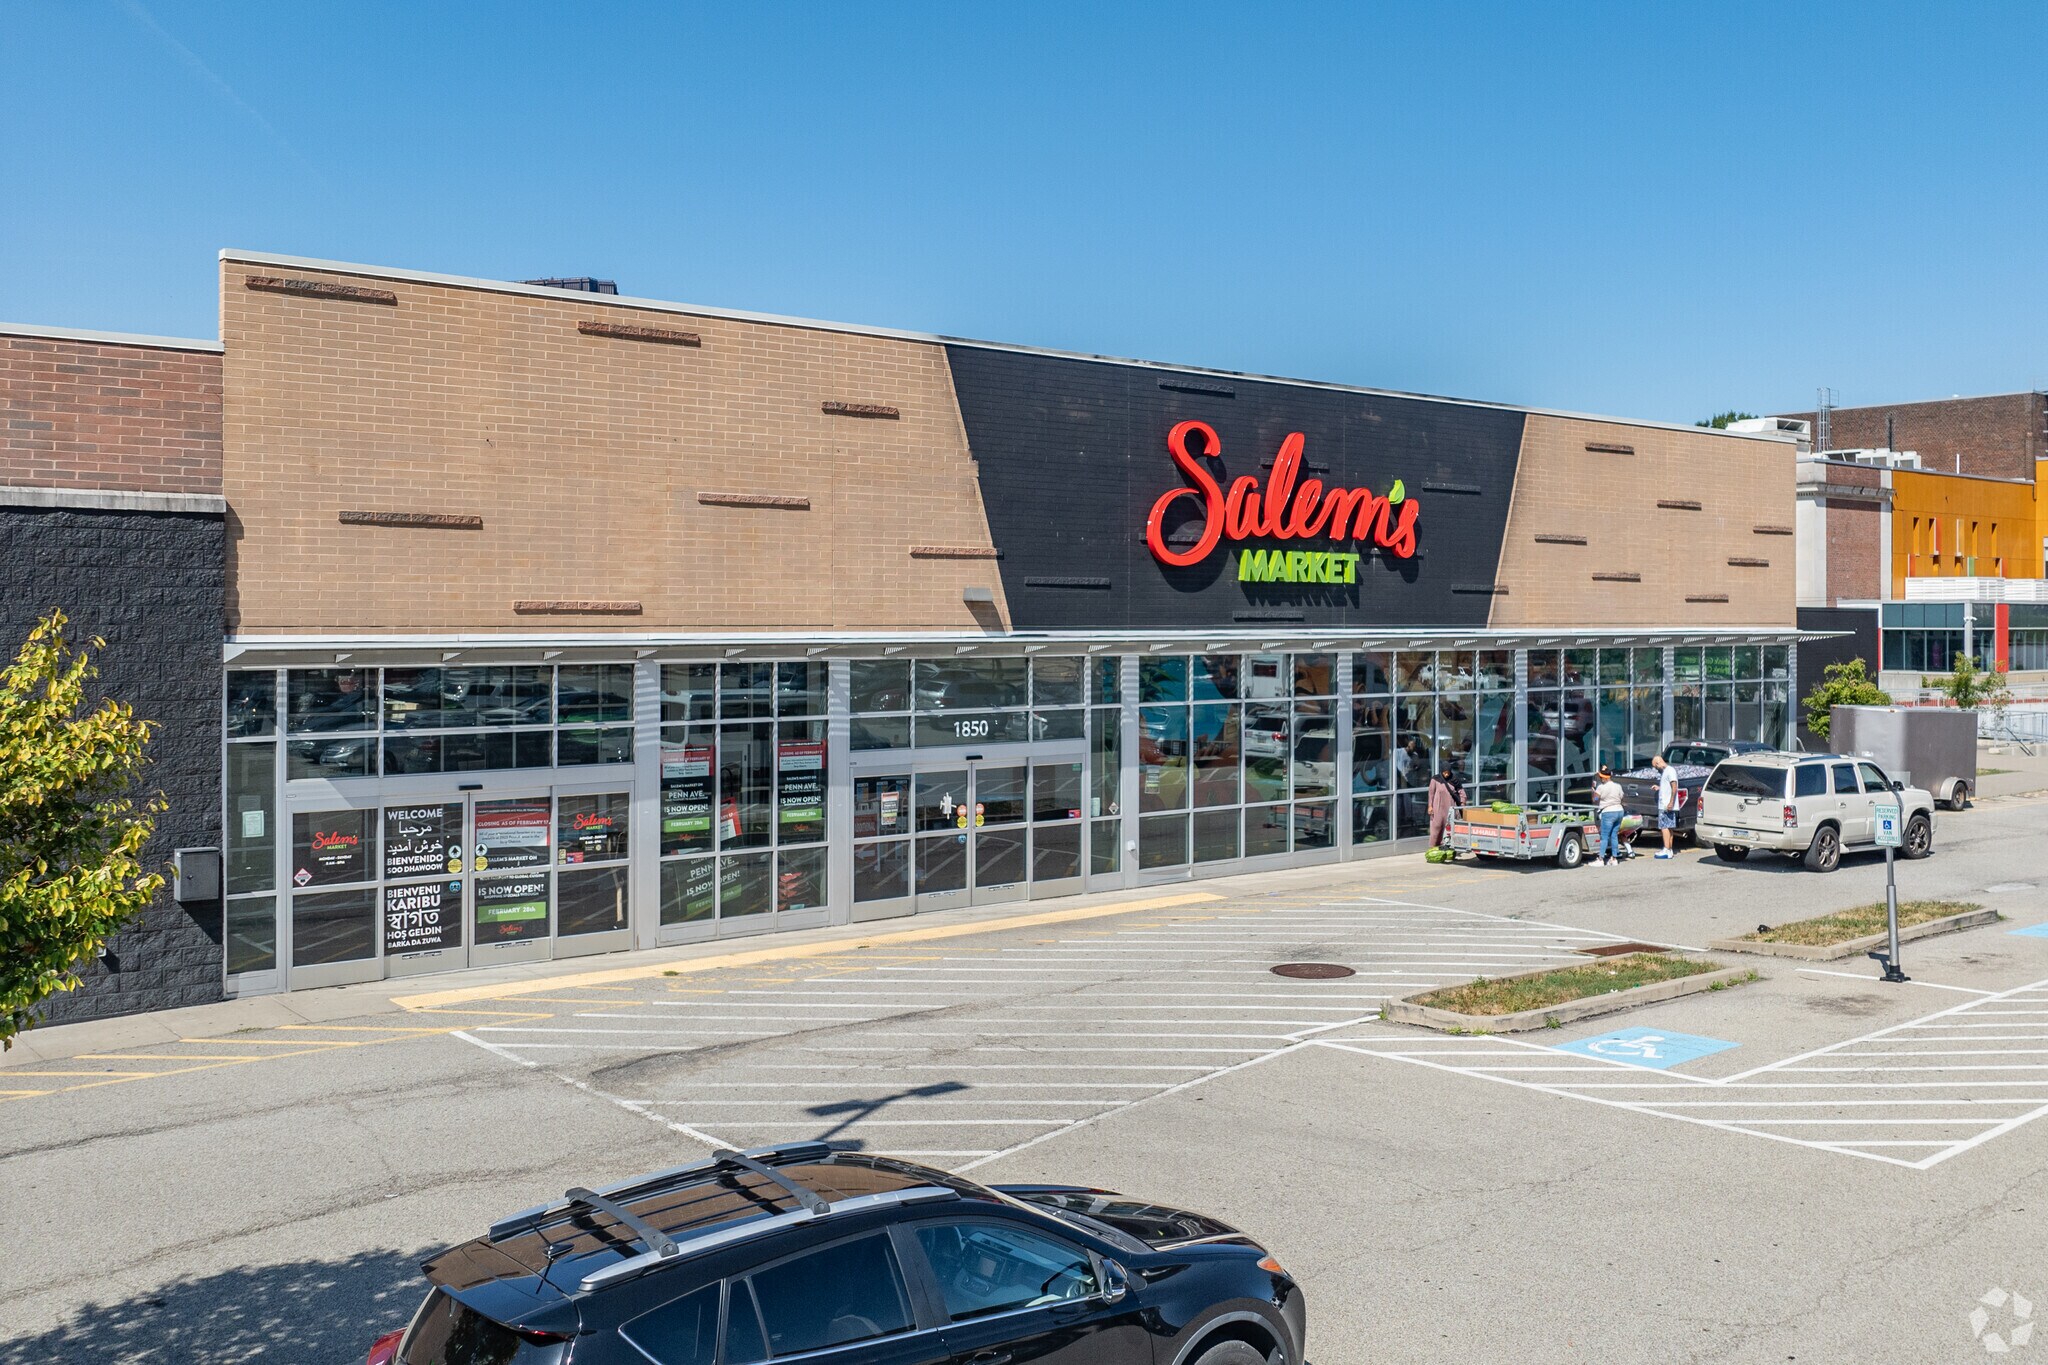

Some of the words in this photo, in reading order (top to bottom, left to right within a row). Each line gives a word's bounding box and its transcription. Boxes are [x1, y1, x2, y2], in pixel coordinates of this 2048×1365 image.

[1146, 420, 1420, 567] Salem's
[1238, 549, 1359, 584] MARKET
[954, 720, 988, 737] 1850
[388, 808, 443, 820] WELCOME
[399, 821, 432, 837] مرحبا
[312, 831, 358, 849] Salem's
[388, 839, 411, 855] آمدید
[415, 840, 443, 853] خوش
[387, 854, 443, 866] BIENVENIDO
[404, 863, 443, 872] DHAWOOW
[387, 885, 440, 899] BIENVENU
[478, 888, 486, 896] IS
[489, 885, 512, 895] NOW
[514, 884, 544, 893] OPEN!
[687, 888, 694, 896] IS
[387, 894, 440, 912] KARIBU
[387, 908, 440, 930] স্বাগত
[387, 930, 407, 940] HOŞ
[408, 926, 442, 937] GELDIN
